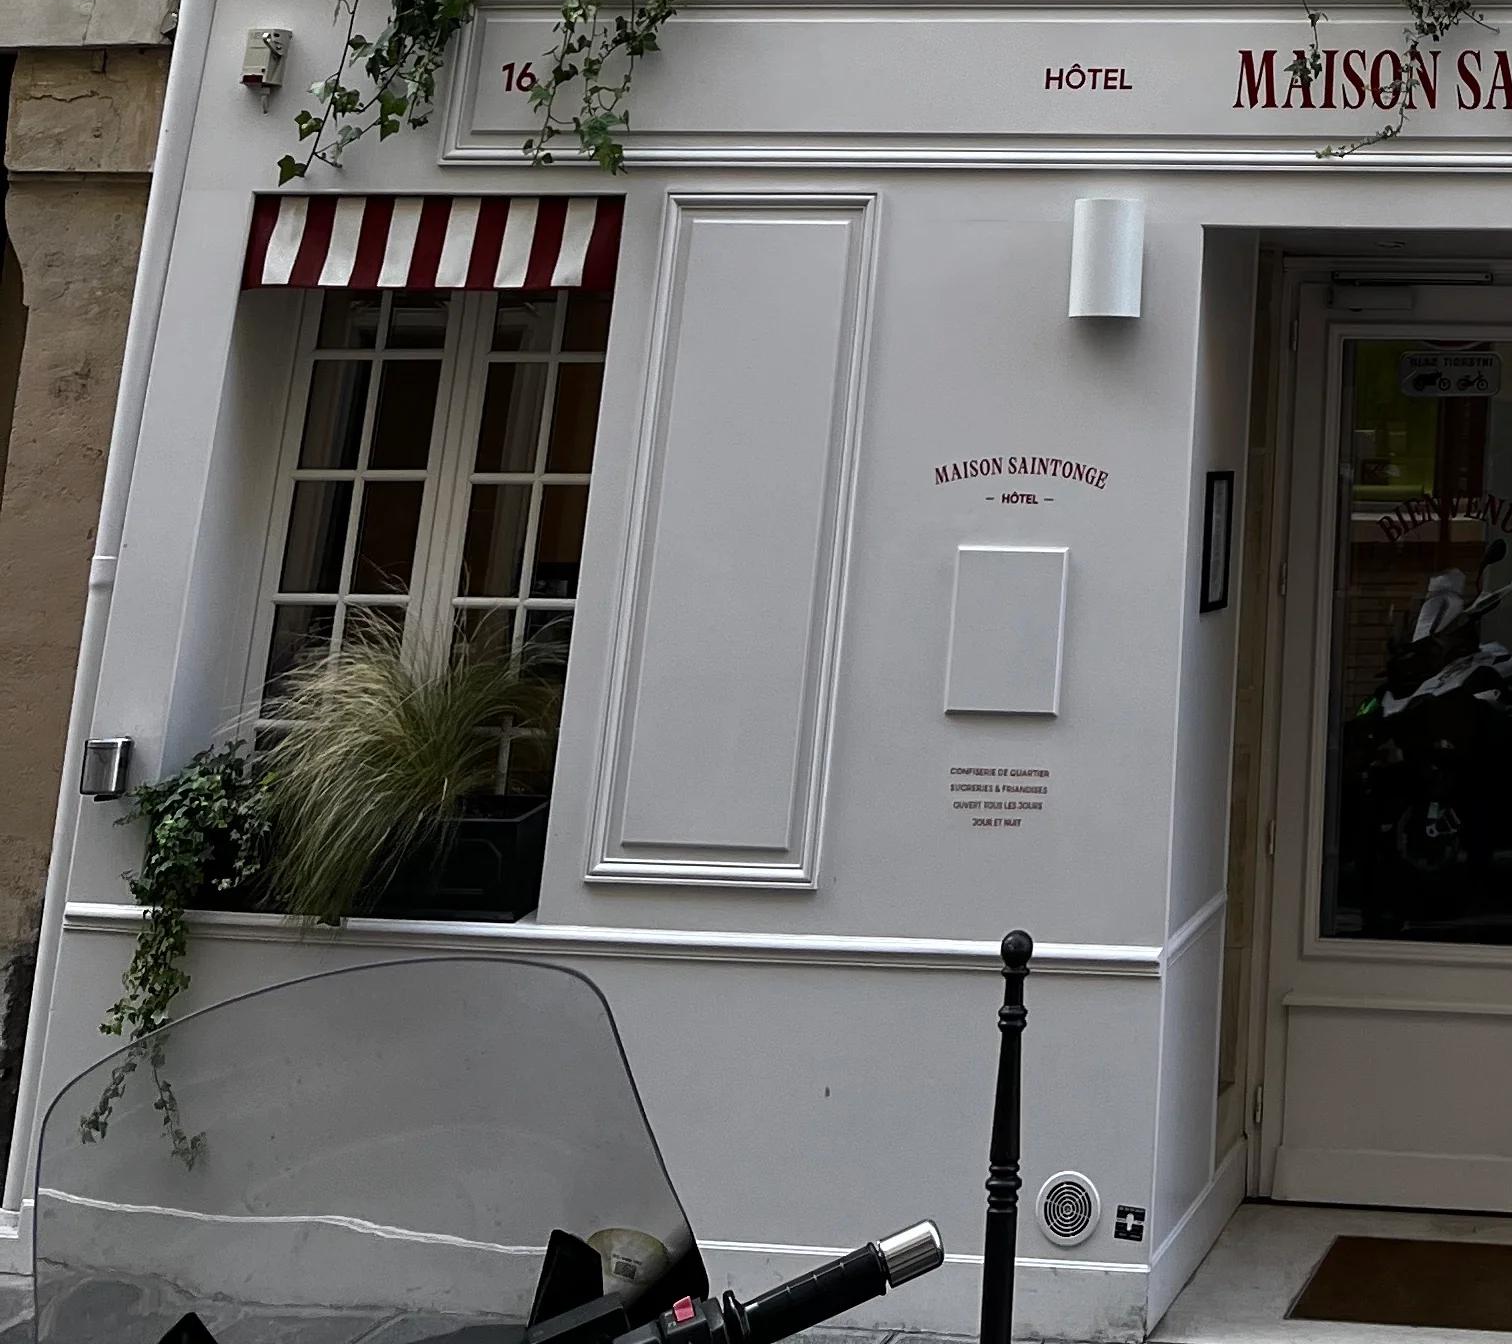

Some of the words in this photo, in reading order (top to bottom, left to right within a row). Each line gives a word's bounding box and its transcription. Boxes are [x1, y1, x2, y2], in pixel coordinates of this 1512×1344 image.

[502, 61, 536, 93] 16
[1045, 63, 1133, 91] HÔTEL
[1232, 49, 1442, 111] MAISON
[934, 456, 1003, 487] MAISON
[1007, 455, 1110, 491] SAINTONGE
[1001, 492, 1039, 505] HÔTEL
[950, 767, 996, 776] CONFISERIE
[997, 768, 1008, 777] DE
[1009, 769, 1050, 778] QUARTIER
